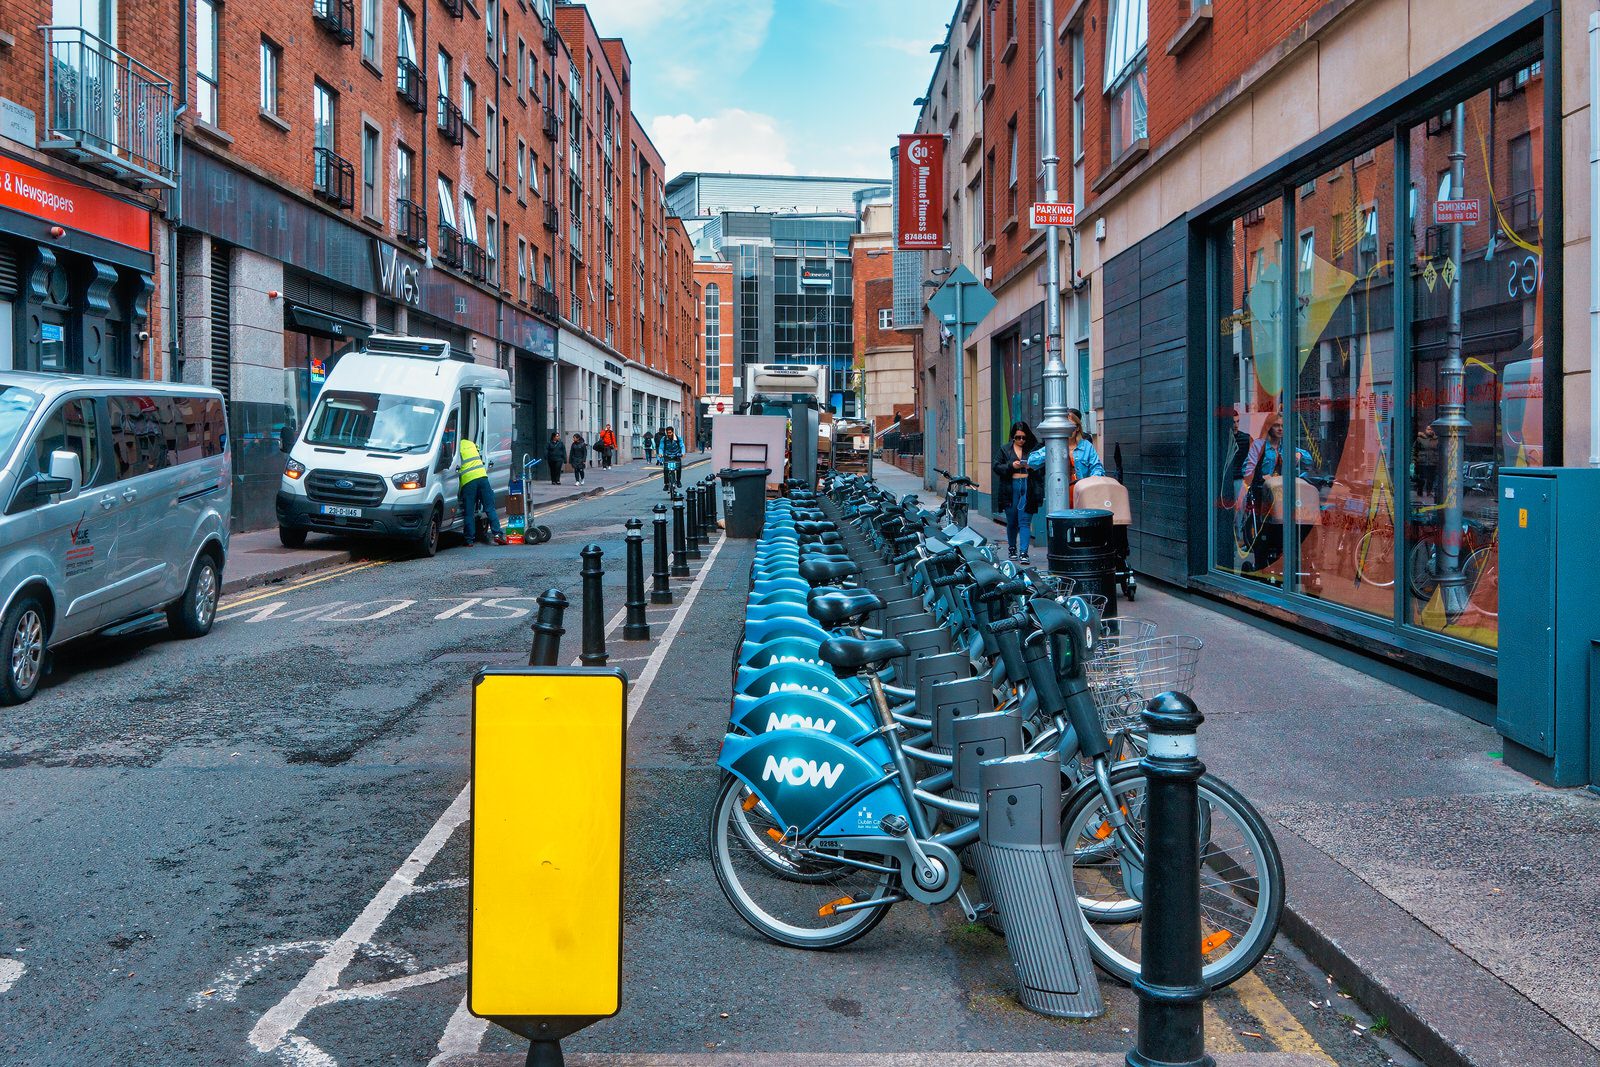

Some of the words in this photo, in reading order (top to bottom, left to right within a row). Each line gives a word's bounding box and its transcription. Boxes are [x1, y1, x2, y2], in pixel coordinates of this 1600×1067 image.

[914, 147, 928, 158] 30
[4, 173, 12, 192] &
[15, 177, 74, 213] Newspapers
[919, 166, 930, 198] Minute
[919, 200, 930, 232] Fitness
[1036, 205, 1072, 214] PARKING
[762, 755, 844, 789] NOW
